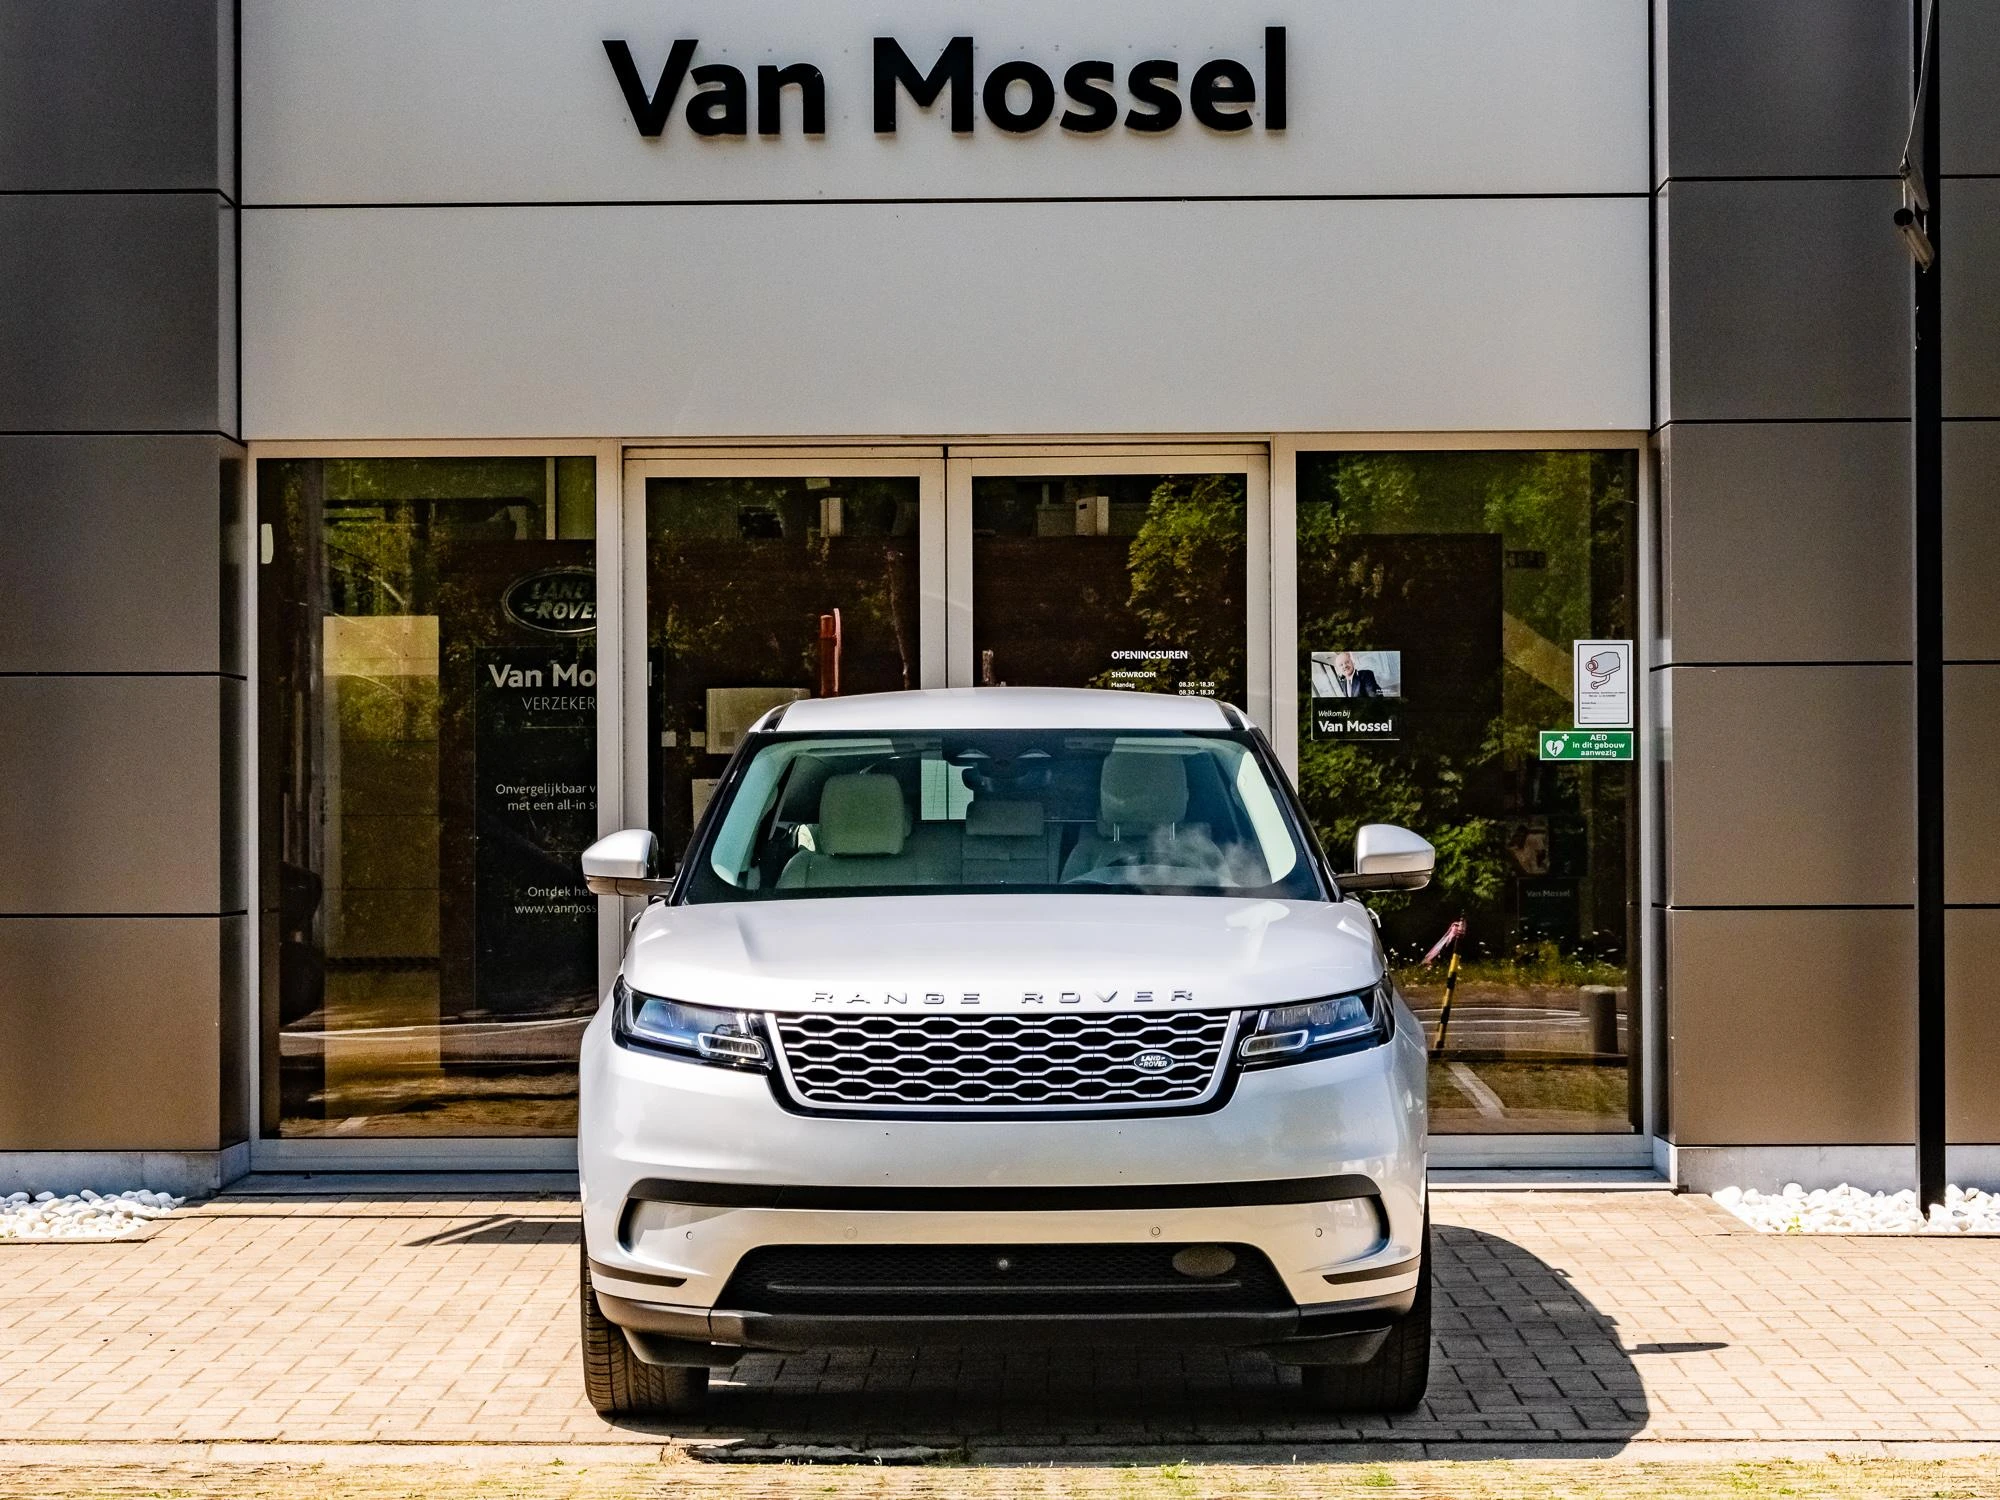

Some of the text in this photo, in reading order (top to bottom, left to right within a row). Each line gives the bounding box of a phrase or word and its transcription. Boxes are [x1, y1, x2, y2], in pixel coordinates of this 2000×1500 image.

[602, 26, 1287, 137] Van Mossel
[1111, 650, 1189, 660] OPENINGSUREN
[488, 663, 543, 688] Van
[1111, 681, 1136, 689] Maandag
[1342, 710, 1351, 718] bij
[1318, 719, 1393, 733] Van Mossel
[1594, 741, 1625, 750] gebouw
[1580, 749, 1617, 757] aanwezig
[495, 783, 587, 797] Onvergelijkbaar
[507, 801, 531, 811] met
[533, 803, 554, 811] een
[557, 800, 586, 811] all-in
[527, 886, 571, 897] Ontdek
[811, 989, 1193, 1005] RANGE ROVER
